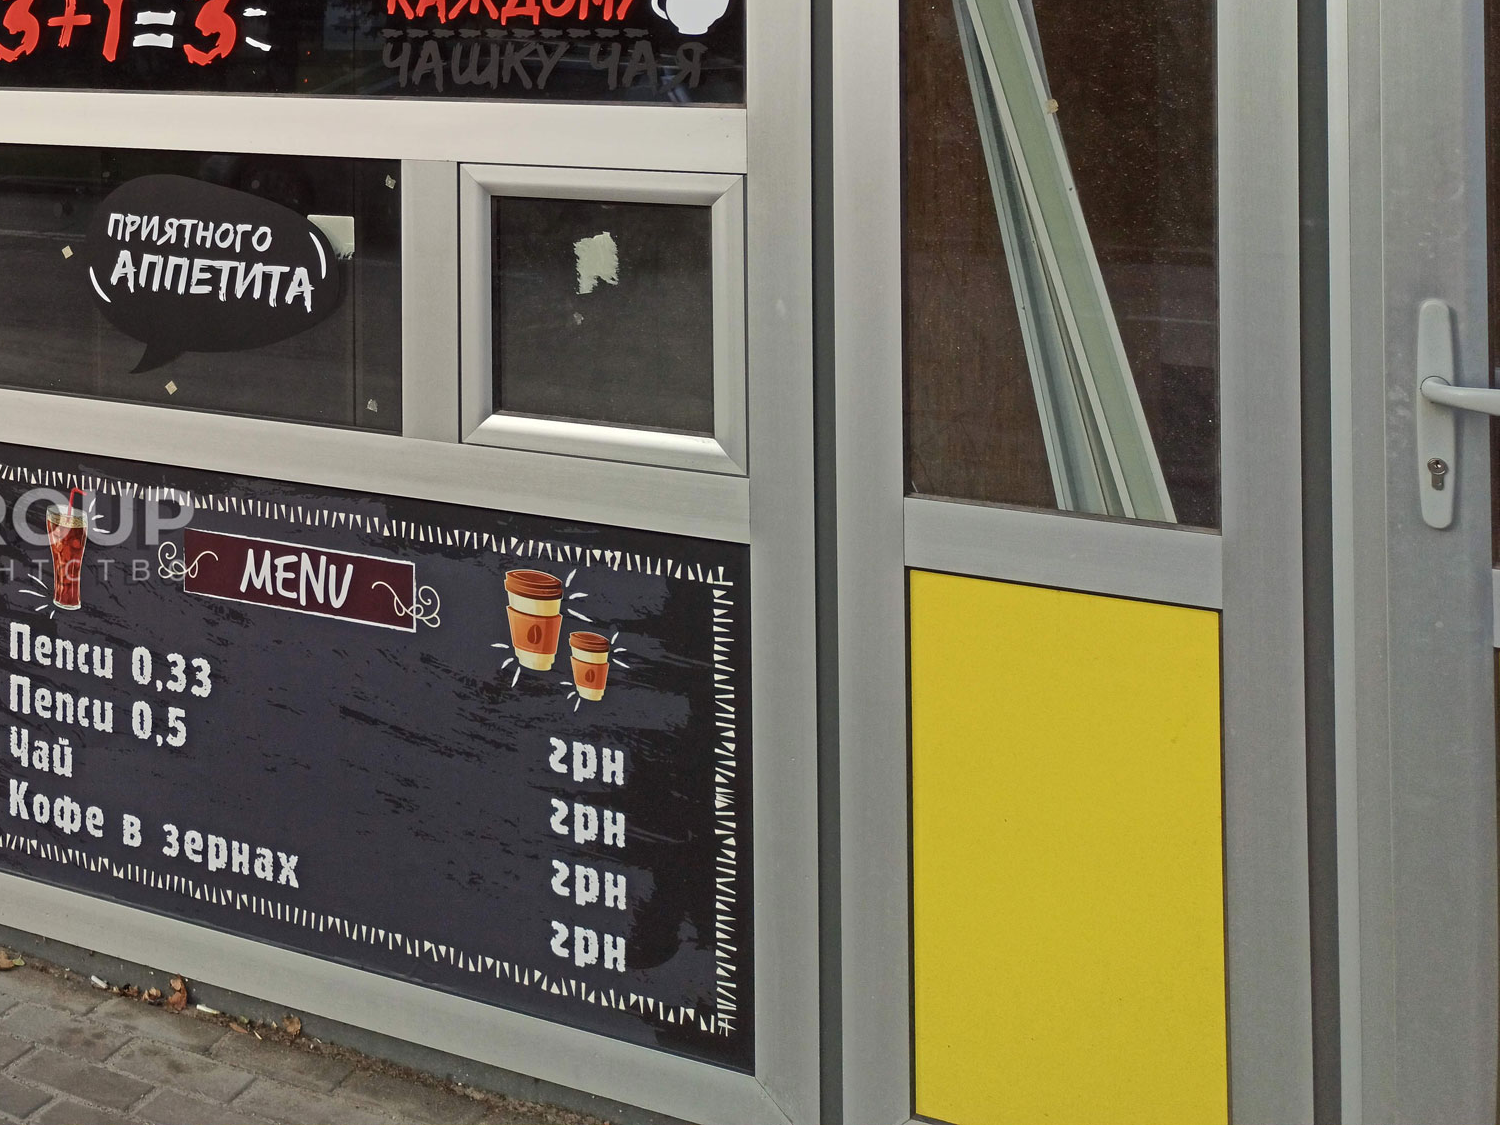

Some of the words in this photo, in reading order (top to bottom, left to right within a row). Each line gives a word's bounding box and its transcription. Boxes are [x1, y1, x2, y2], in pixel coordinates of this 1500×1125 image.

[381, 39, 572, 93] ЧАШКУ
[107, 212, 273, 253] ПРИЯТНОГО
[110, 249, 316, 313] АППЕТИТА
[239, 548, 354, 609] MENU
[8, 621, 114, 680] Пепси
[130, 645, 213, 698] 0,33
[8, 674, 114, 734] Пепси
[130, 700, 188, 748] 0,5
[8, 725, 74, 779] Чай
[8, 778, 105, 838] Кофе
[122, 813, 142, 848] в
[161, 822, 300, 889] зернах
